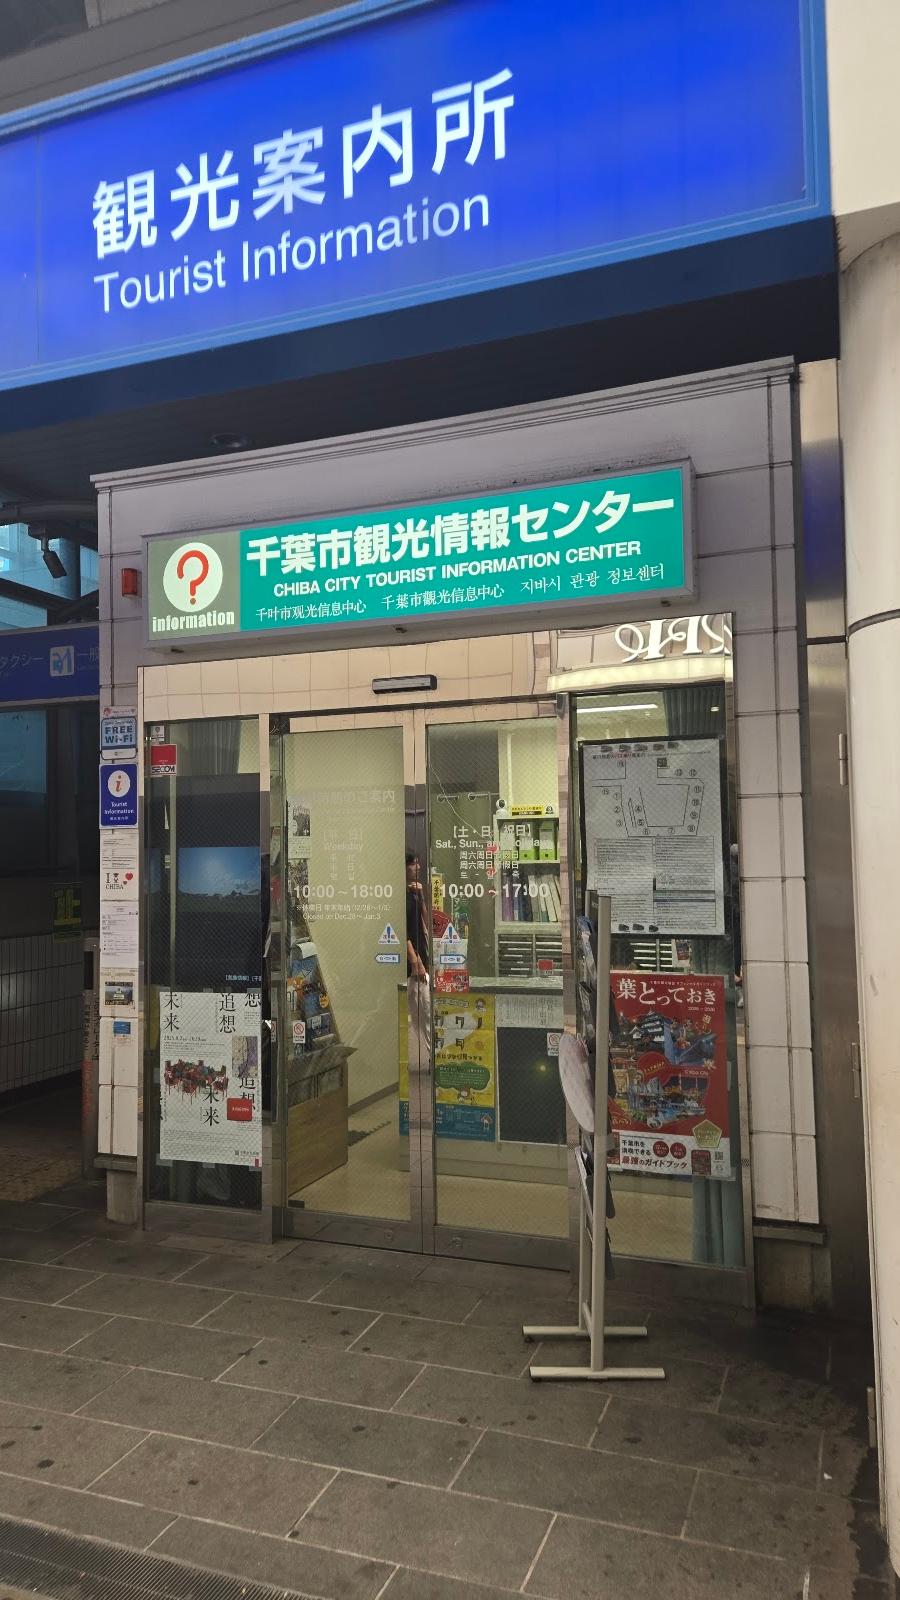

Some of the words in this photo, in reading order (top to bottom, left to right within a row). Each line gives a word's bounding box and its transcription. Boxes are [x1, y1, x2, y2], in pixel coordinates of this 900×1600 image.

[93, 68, 516, 260] 観光案内所
[94, 250, 227, 314] Tourist
[242, 194, 489, 281] Information
[246, 490, 674, 576] 千葉市観光情報センター
[273, 581, 320, 597] CHIBA
[324, 576, 360, 594] CITY
[366, 565, 436, 587] TOURIST
[441, 550, 560, 579] INFORMATION
[565, 540, 641, 564] CENTER
[521, 575, 561, 595] 지바시
[569, 572, 600, 589] 관광
[607, 563, 664, 583] 정보센터
[381, 583, 505, 610] 千葉市觀光信息中心
[152, 611, 235, 632] information
[256, 599, 367, 623] 千叶市观光信息中心
[105, 725, 133, 735] FREE
[105, 734, 133, 744] Wi-Fi
[151, 765, 175, 774] SECOM
[435, 840, 457, 849] Sat.,
[459, 839, 484, 849] Sun.,
[621, 1156, 688, 1169] 最強のガイドブック
